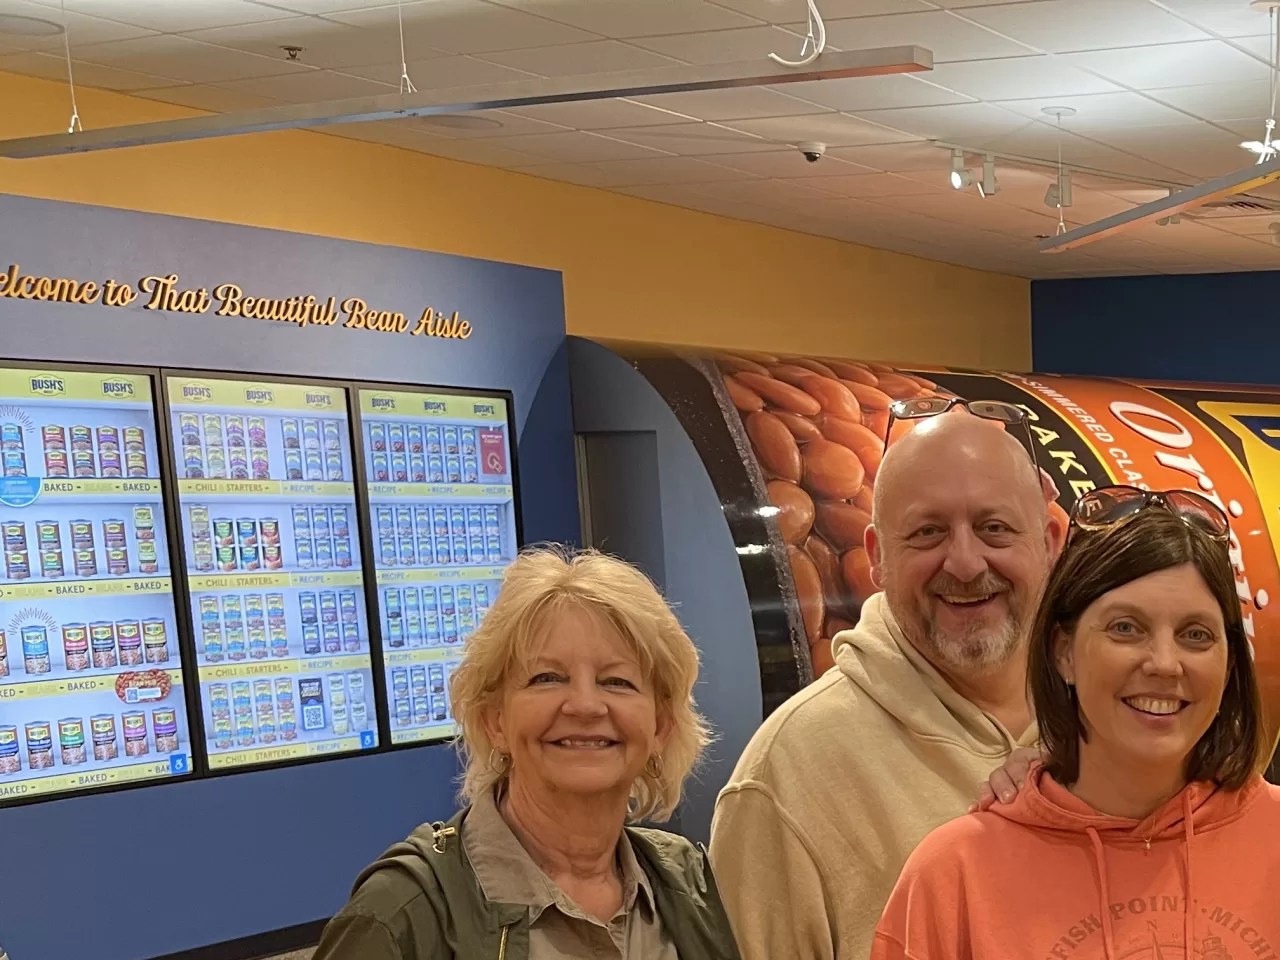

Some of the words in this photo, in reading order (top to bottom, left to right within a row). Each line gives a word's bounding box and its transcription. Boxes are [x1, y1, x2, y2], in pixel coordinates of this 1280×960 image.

[0, 264, 100, 305] elcome
[102, 278, 136, 307] to
[139, 273, 211, 314] That
[213, 283, 338, 328] Beautiful
[341, 297, 409, 336] Bean
[411, 306, 474, 341] Aisle
[32, 379, 63, 391] BUSH'S
[103, 382, 133, 394] BUSH'S
[183, 386, 211, 398] BUSH'S
[44, 483, 73, 492] BAKED
[123, 483, 150, 491] BAKED
[195, 483, 217, 492] CHILI
[226, 483, 263, 492] STARTERS
[56, 585, 85, 595] BAKED
[134, 581, 161, 590] BAKED
[206, 578, 227, 587] CHILI
[236, 577, 273, 586] STARTERS
[216, 667, 236, 677] CHILI
[246, 664, 282, 675] STARTERS
[0, 688, 15, 697] KED
[68, 680, 96, 690] BAKED
[225, 755, 246, 765] CHILI
[79, 773, 107, 784] BAKED
[155, 765, 169, 774] BAK
[1110, 894, 1197, 921] POIN
